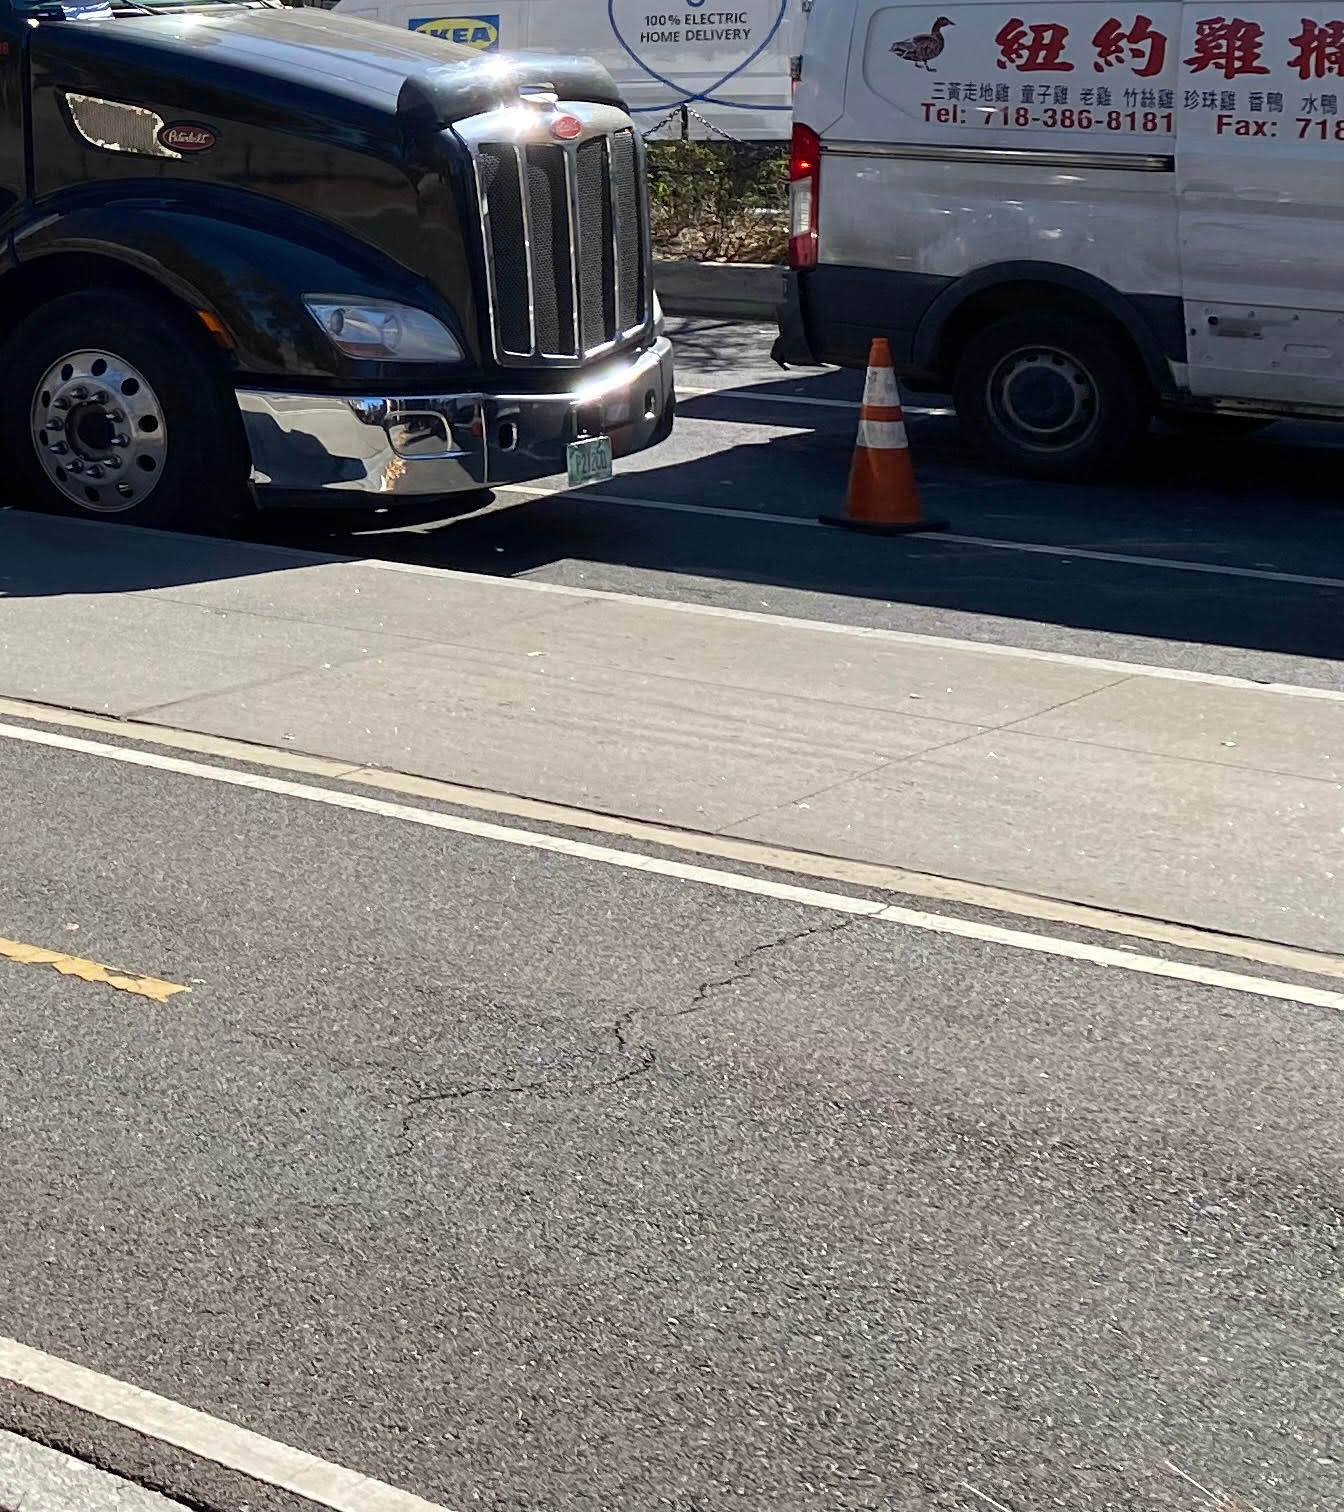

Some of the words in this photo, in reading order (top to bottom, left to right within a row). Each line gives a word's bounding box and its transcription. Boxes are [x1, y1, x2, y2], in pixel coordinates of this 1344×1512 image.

[685, 12, 748, 25] ELECTRIC
[416, 27, 492, 43] KEA
[640, 31, 681, 43] HOME
[685, 28, 752, 41] DELIVERY
[921, 103, 966, 124] Tel:
[976, 105, 1173, 133] 718-386-8181
[1216, 114, 1278, 137] Fax:
